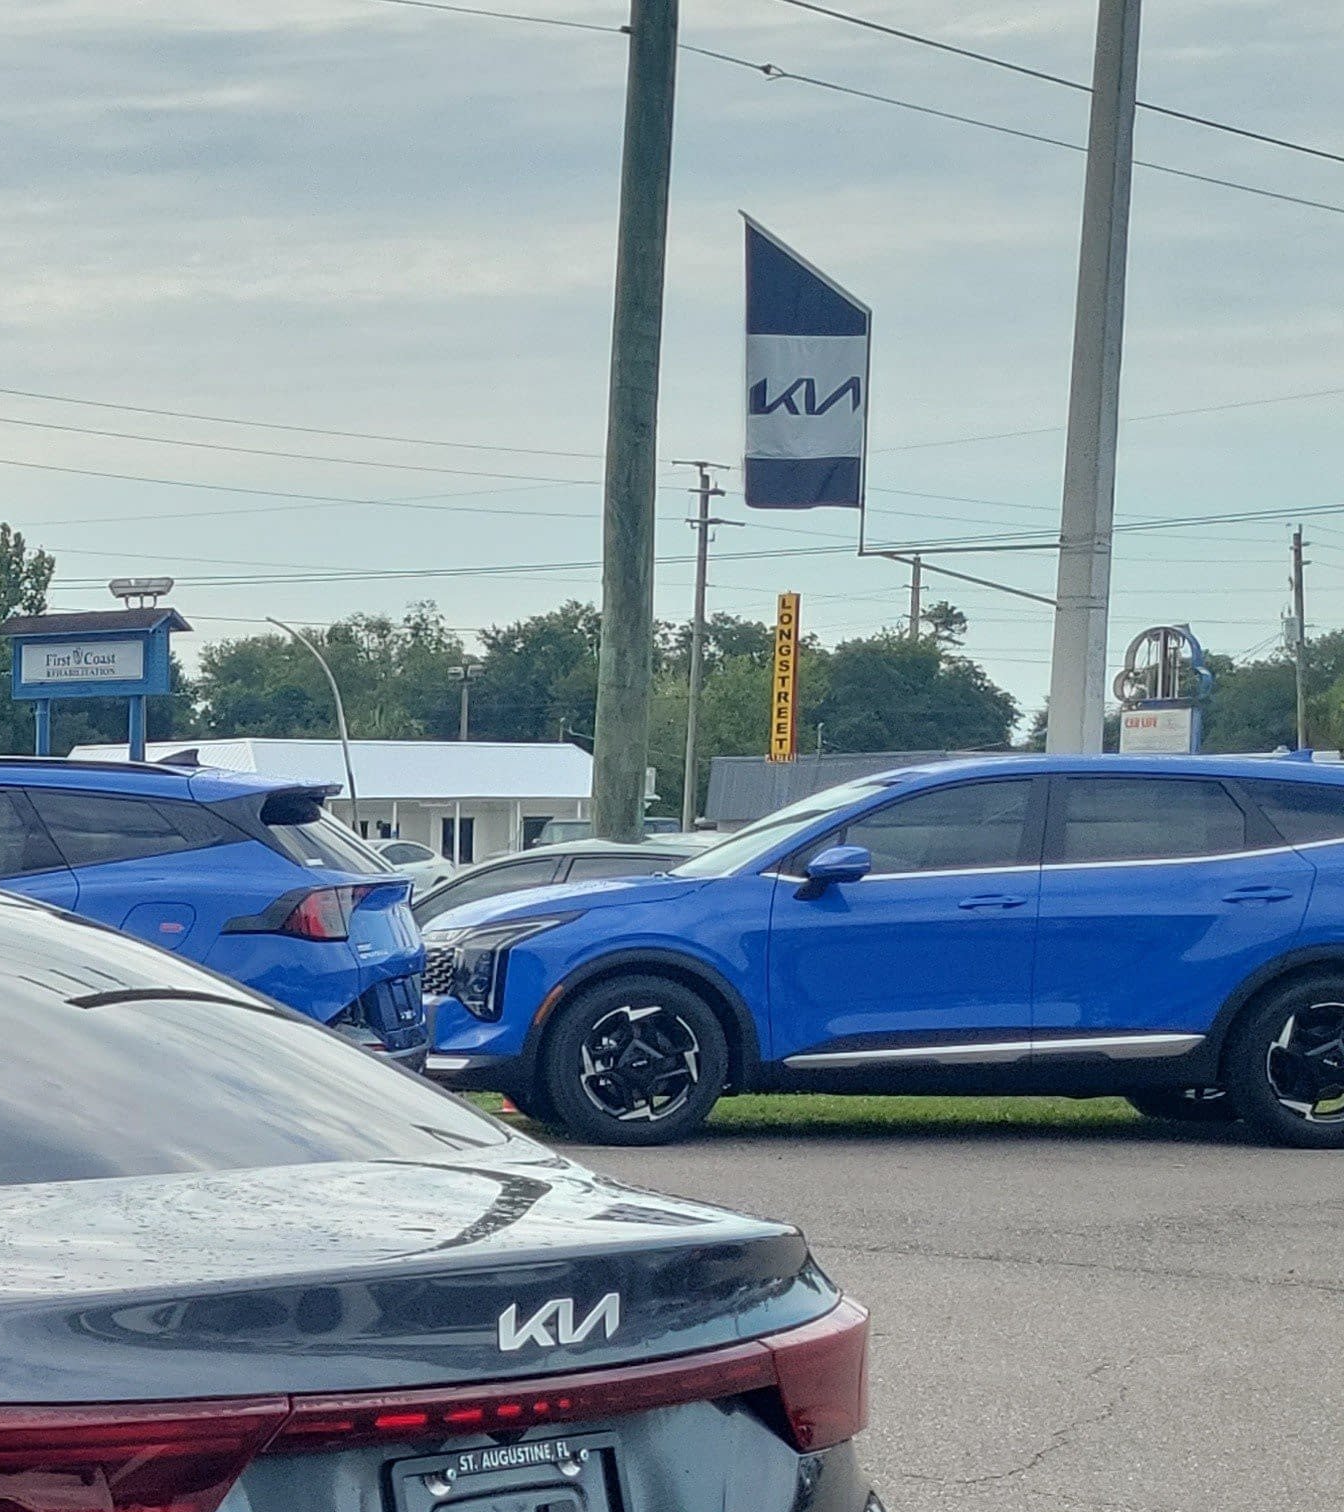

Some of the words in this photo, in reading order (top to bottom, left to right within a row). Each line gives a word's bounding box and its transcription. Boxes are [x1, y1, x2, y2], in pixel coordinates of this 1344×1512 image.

[749, 376, 861, 416] KIA
[45, 653, 71, 667] First
[83, 651, 116, 666] Coast
[775, 597, 793, 750] LONGSTREET
[498, 1291, 621, 1352] KIA
[459, 1456, 478, 1471] ST.
[482, 1444, 555, 1469] AUGUSTINE,
[556, 1441, 570, 1458] FL
